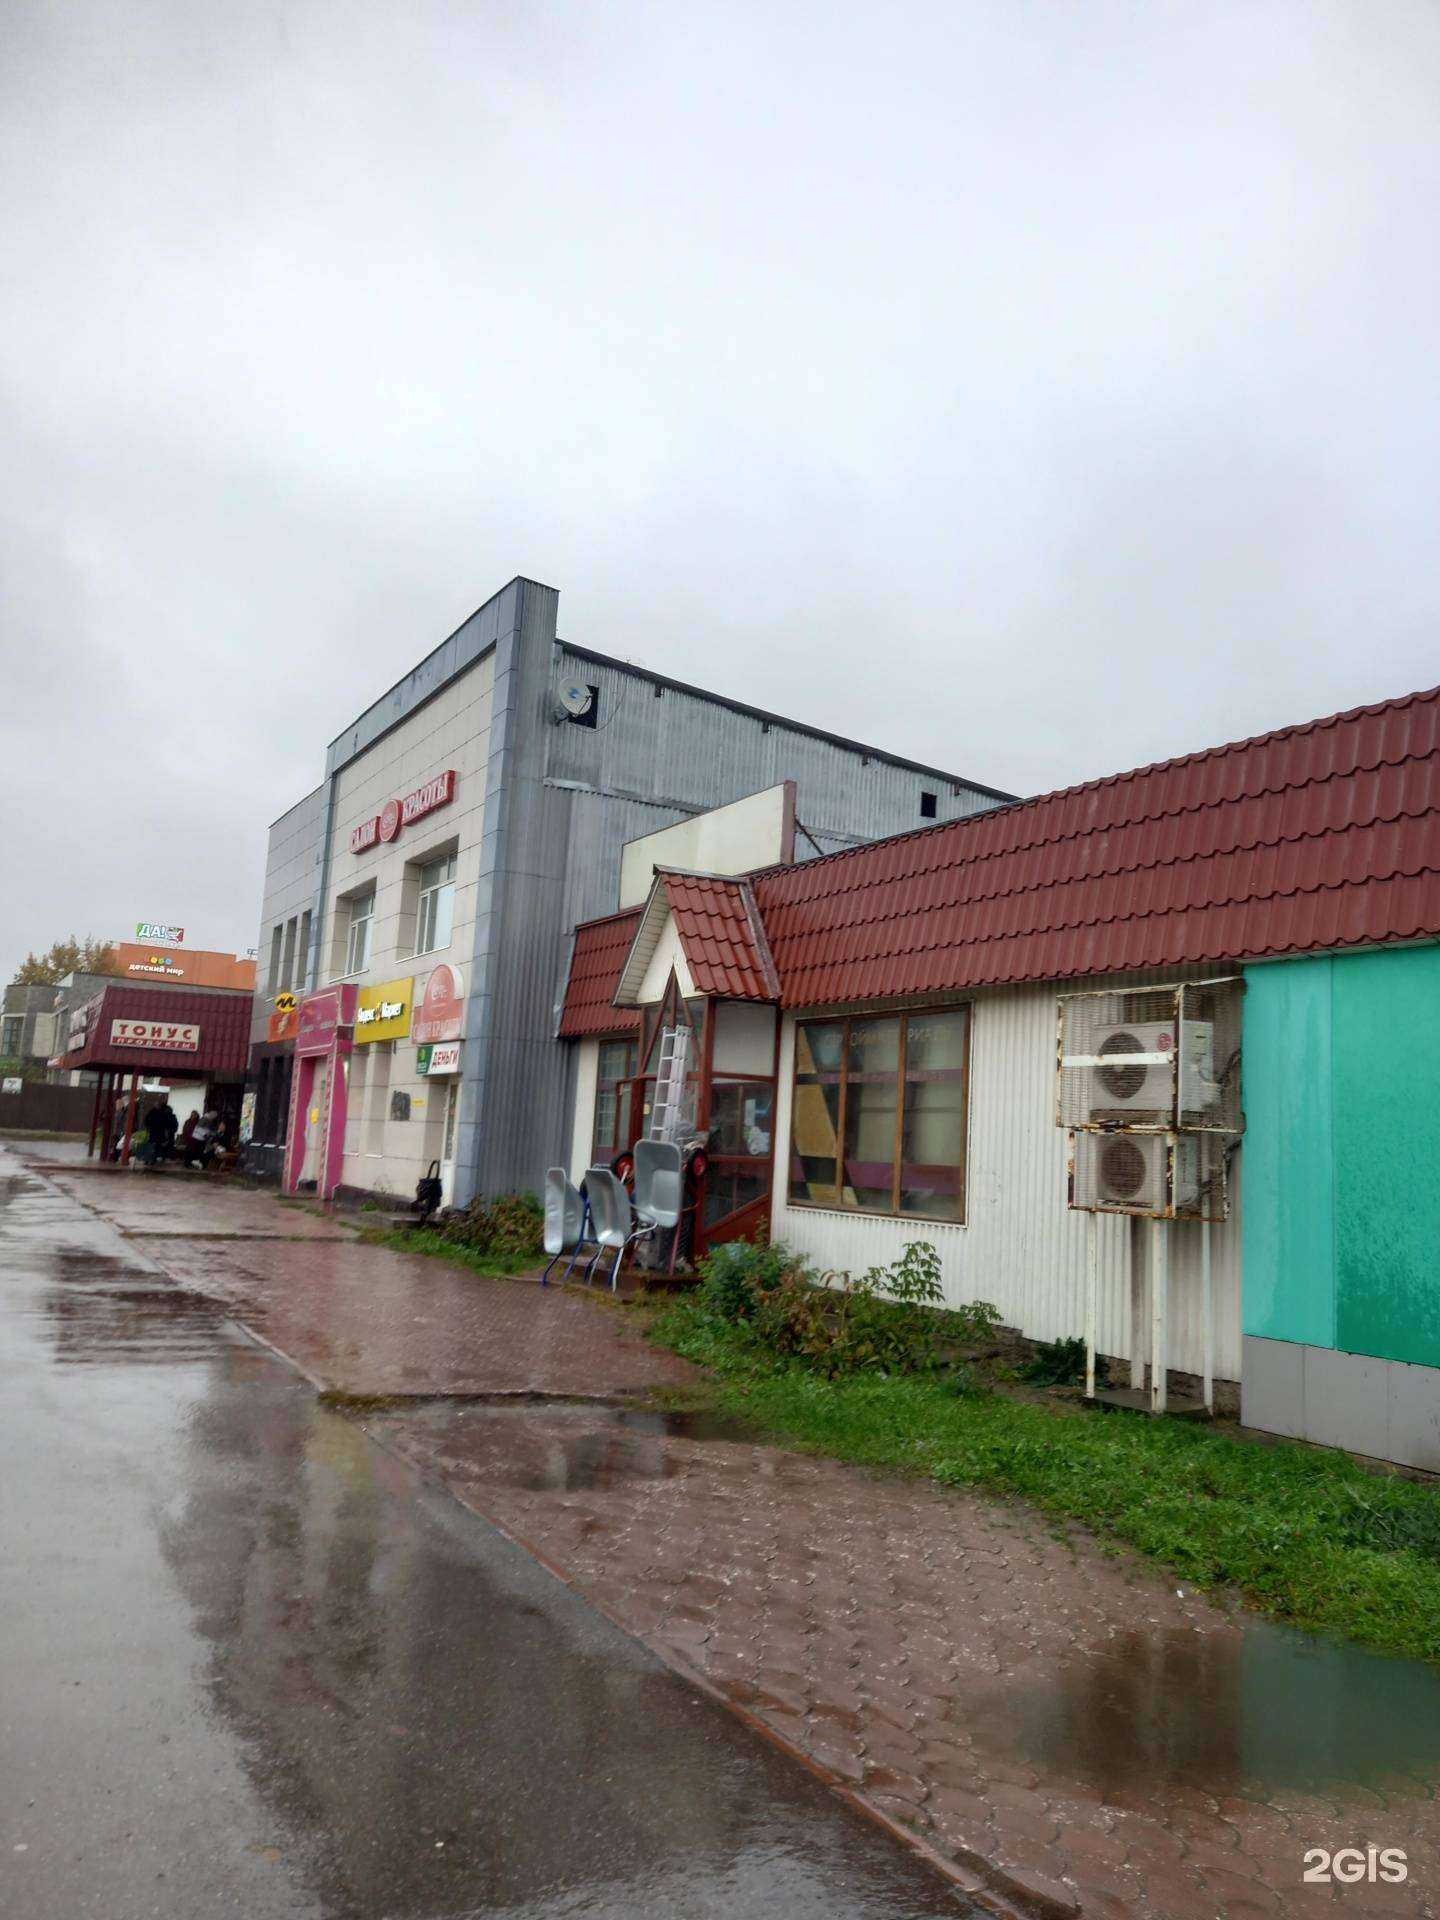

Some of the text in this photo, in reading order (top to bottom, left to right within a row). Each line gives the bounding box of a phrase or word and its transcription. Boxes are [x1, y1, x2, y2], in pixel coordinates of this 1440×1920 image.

[351, 773, 448, 850] САЛОН КРАСОТЫ
[128, 963, 184, 977] детский мир
[119, 1024, 192, 1039] ТОНУС
[431, 1049, 459, 1069] ДЕНЬГИ
